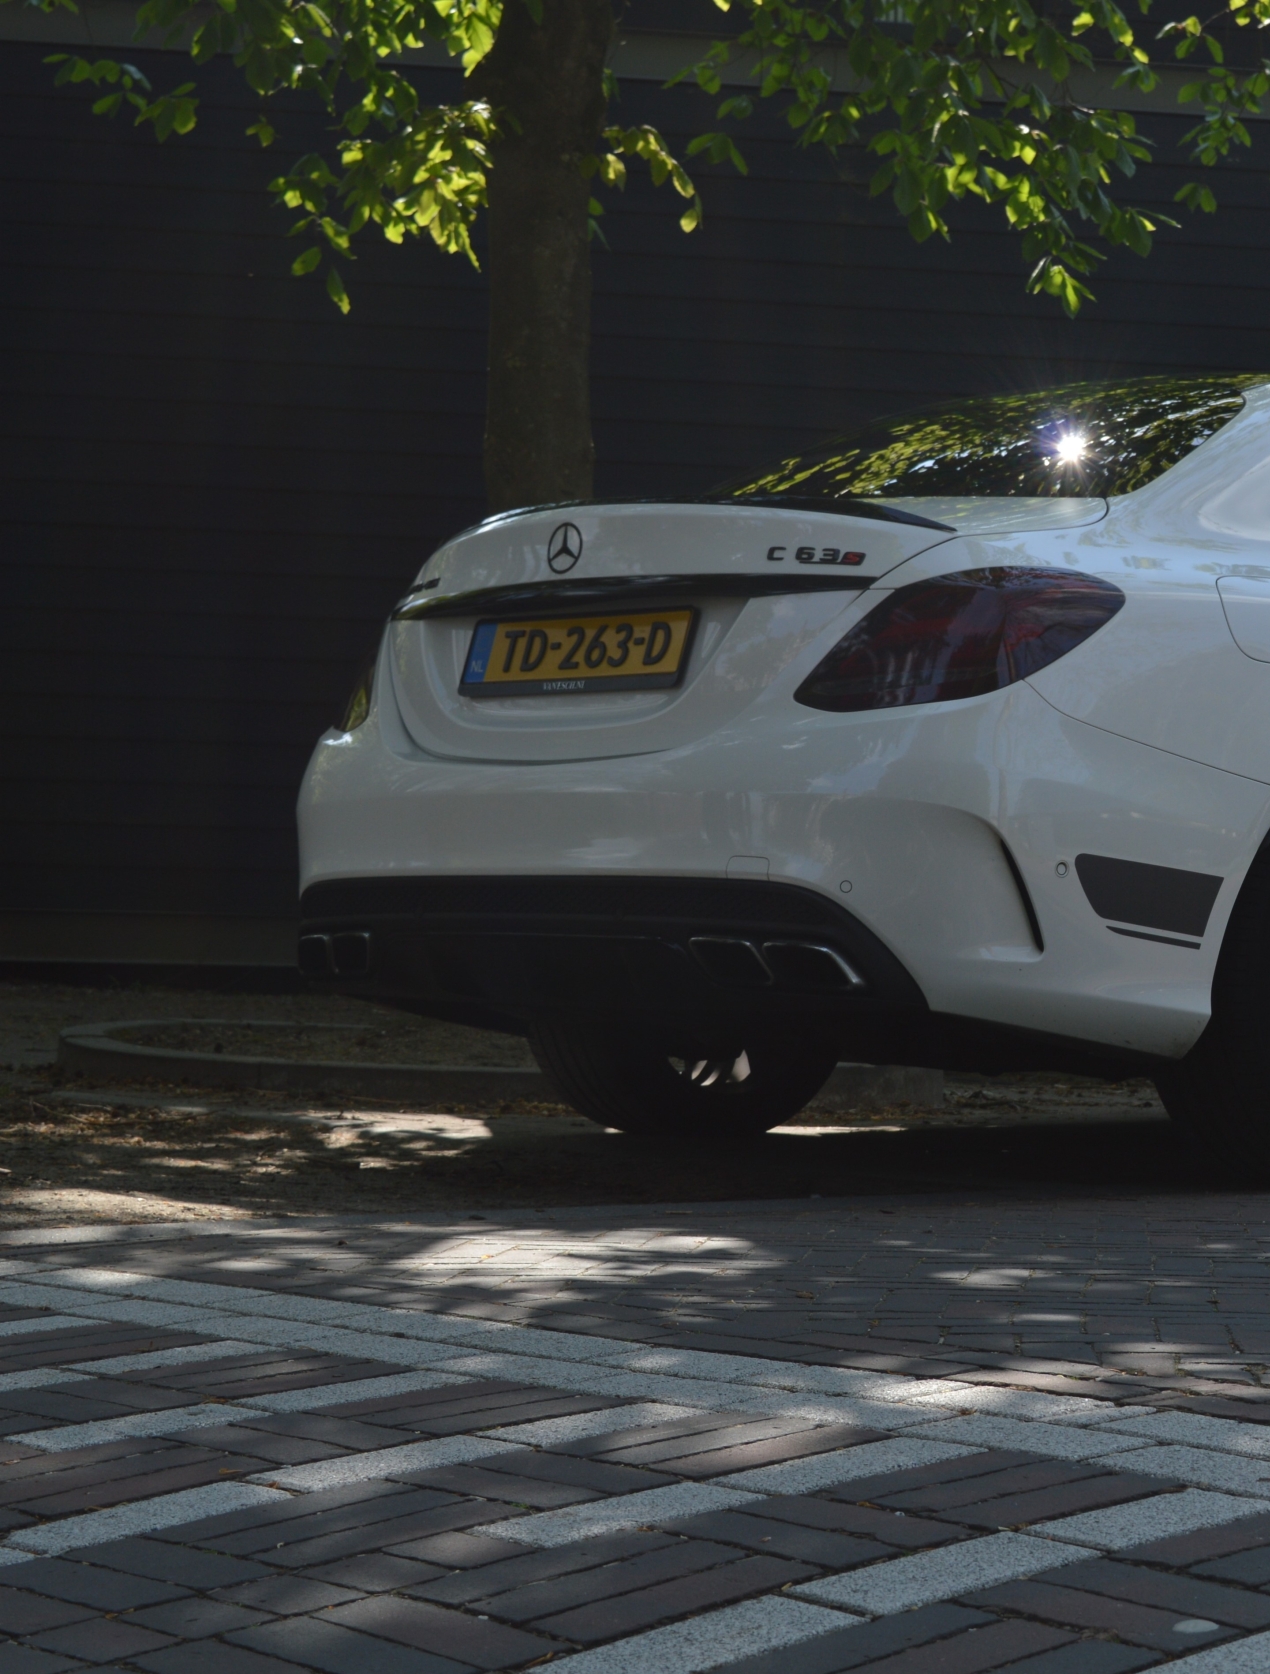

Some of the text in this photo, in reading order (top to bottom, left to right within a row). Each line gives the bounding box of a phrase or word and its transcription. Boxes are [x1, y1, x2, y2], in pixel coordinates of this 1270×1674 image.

[767, 546, 787, 561] C
[501, 621, 673, 673] TD-263-D
[470, 660, 484, 673] NL
